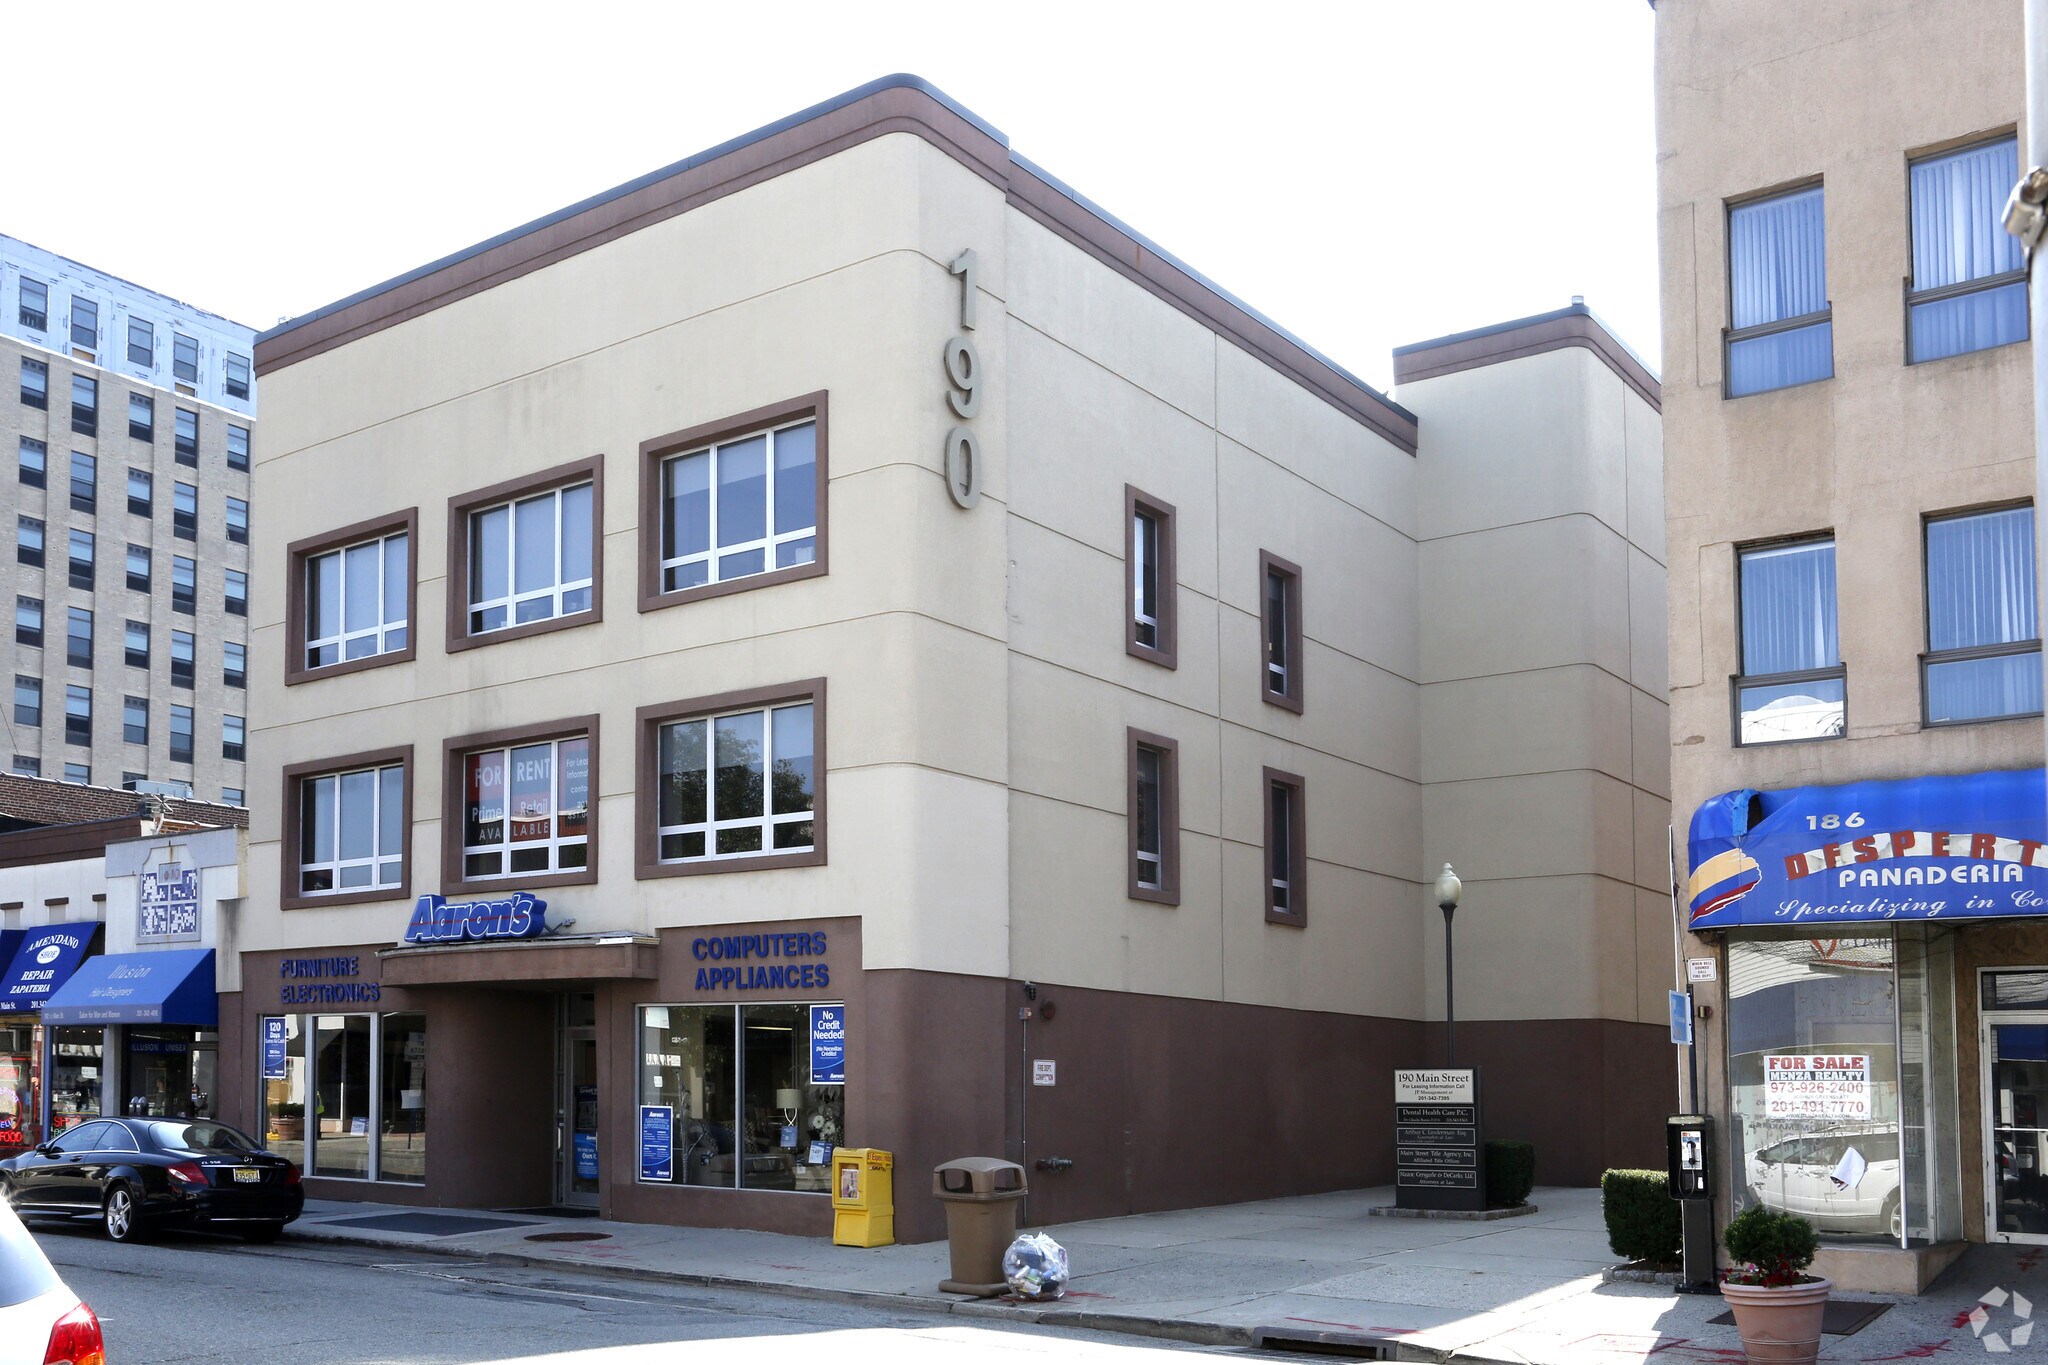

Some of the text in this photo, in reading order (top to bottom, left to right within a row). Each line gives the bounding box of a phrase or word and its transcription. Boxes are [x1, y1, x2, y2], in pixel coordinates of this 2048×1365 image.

[944, 247, 982, 510] 190
[475, 758, 550, 788] FOR RENT
[472, 798, 548, 822] Prime Retail
[1806, 812, 1865, 831] 186
[479, 822, 549, 841] AVALABLE
[1839, 863, 2023, 888] PANADERIA
[1774, 889, 2048, 921] Specializing in Co
[404, 892, 544, 943] Aaron's
[26, 934, 79, 954] AMENDANO
[692, 931, 827, 961] COMPUTERS
[21, 969, 55, 981] REPAIR
[108, 964, 152, 979] Illusion
[280, 956, 360, 979] FURNITURE
[695, 964, 830, 990] APPLIANCES
[9, 984, 51, 994] ZAPATERIA
[281, 982, 381, 1005] ELECTRONICS
[818, 1020, 840, 1030] Credit
[822, 1011, 834, 1020] No
[269, 1022, 281, 1032] 120
[813, 1030, 844, 1040] Needed!
[1769, 1057, 1864, 1069] FOR SALE
[1398, 1073, 1469, 1082] 190 Main Street
[1770, 1071, 1864, 1081] MENZA REALTY
[1771, 1082, 1864, 1094] 973-926-2400
[1772, 1101, 1864, 1112] 201-491-7770
